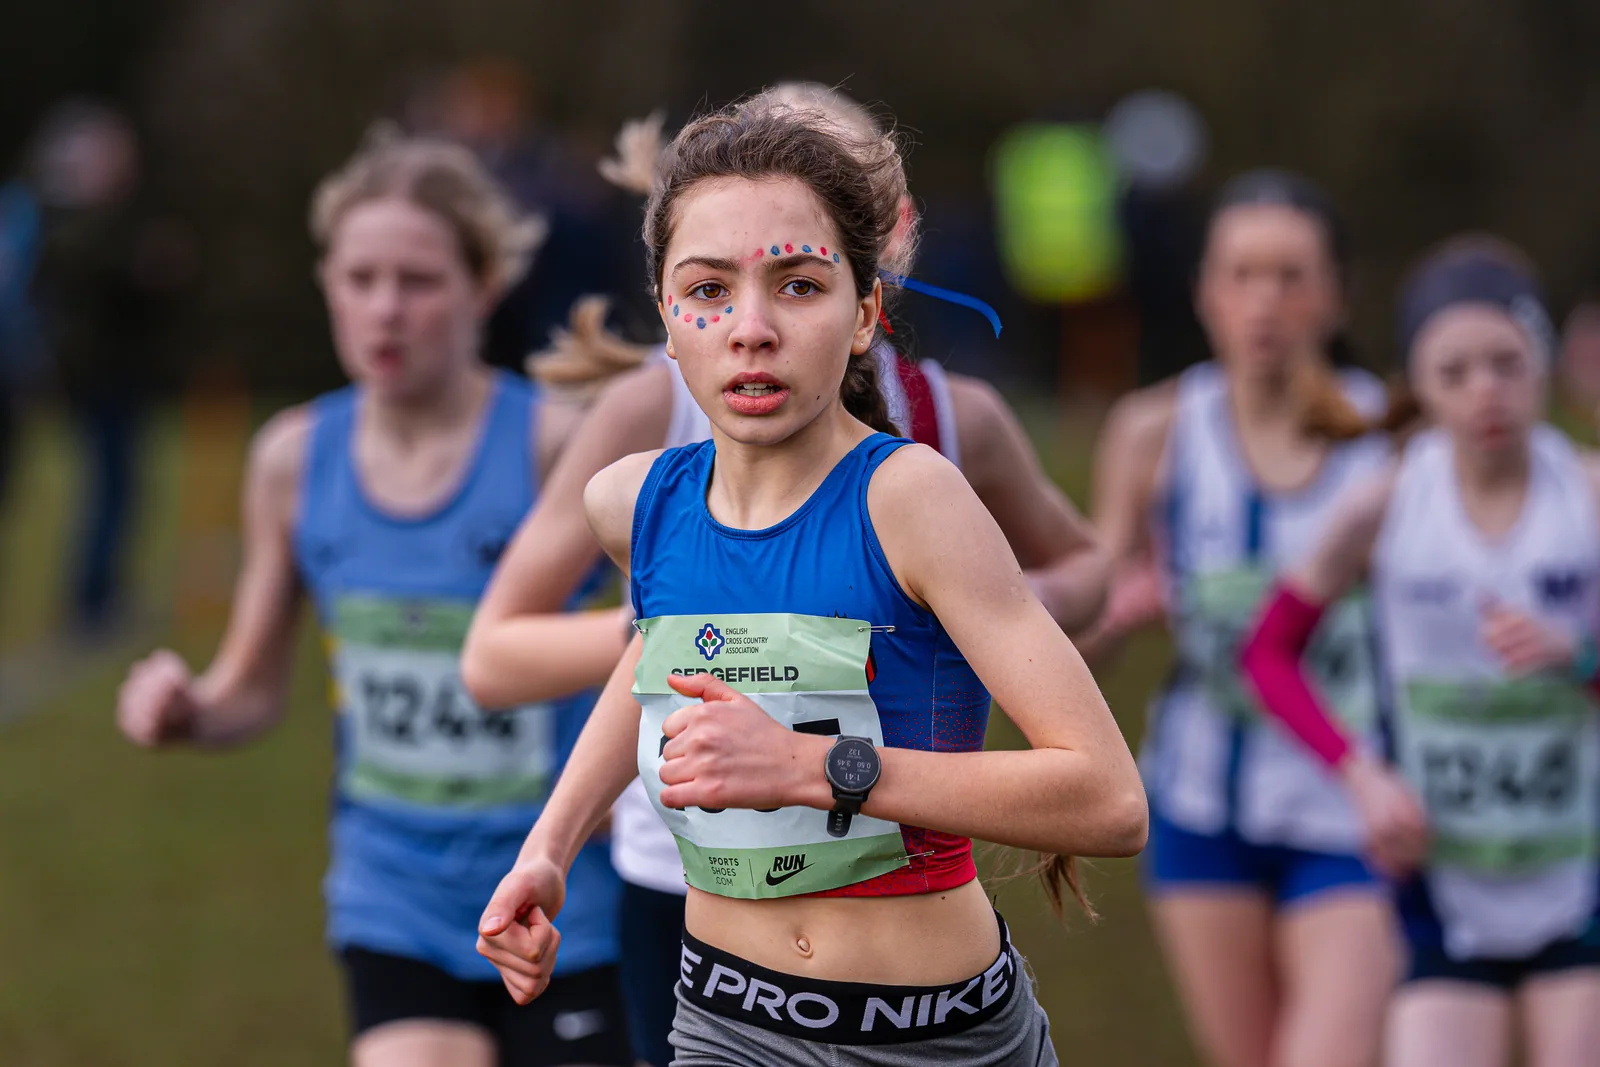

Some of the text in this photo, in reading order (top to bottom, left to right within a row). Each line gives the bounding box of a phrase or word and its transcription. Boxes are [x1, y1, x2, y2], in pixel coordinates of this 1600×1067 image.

[708, 856, 739, 866] SPORTS
[773, 854, 806, 872] RUN
[711, 866, 737, 877] SHOES
[702, 962, 839, 1028] PRO
[860, 951, 1008, 1032] NIKE
